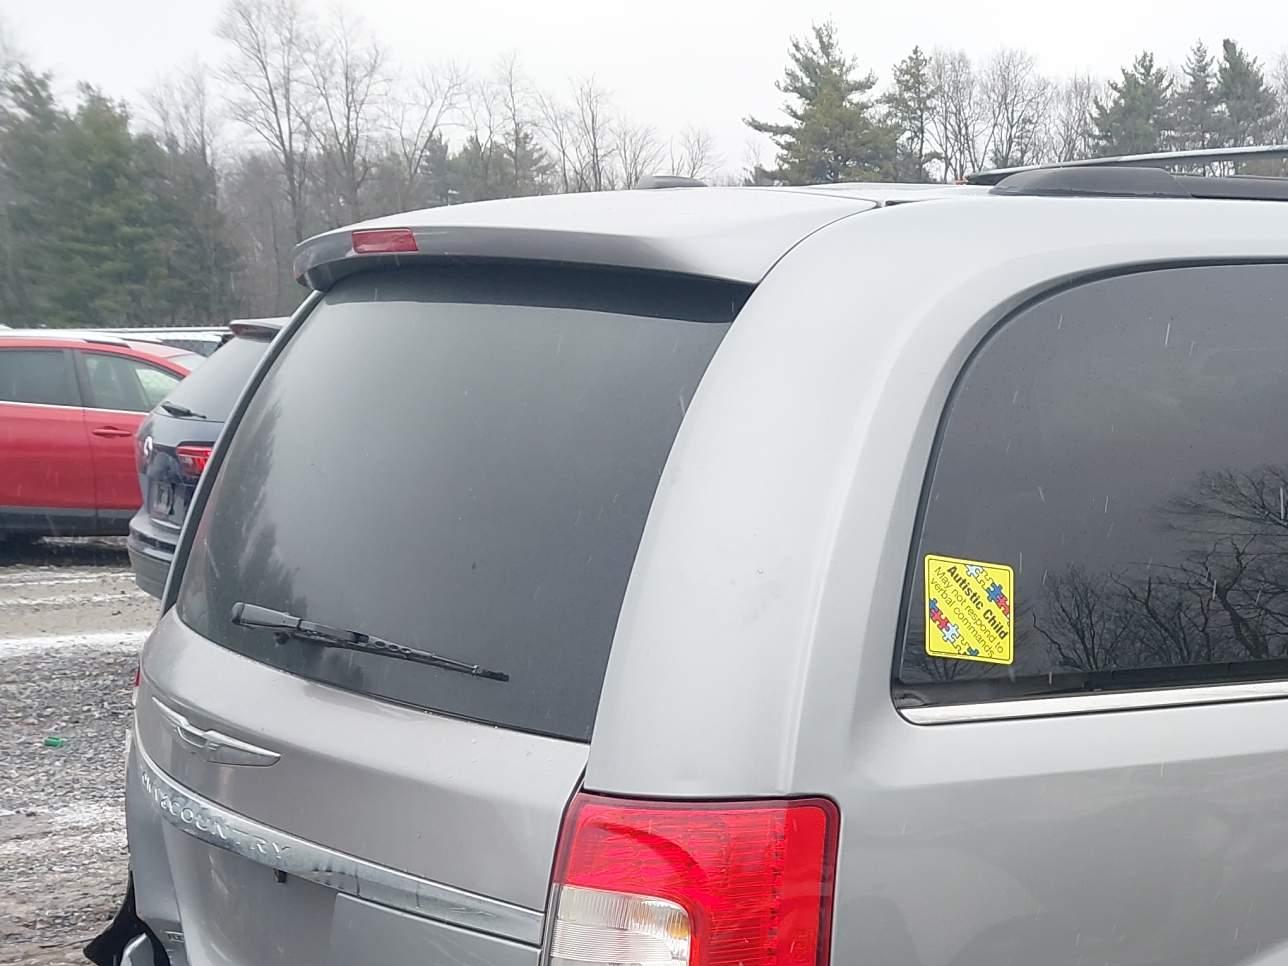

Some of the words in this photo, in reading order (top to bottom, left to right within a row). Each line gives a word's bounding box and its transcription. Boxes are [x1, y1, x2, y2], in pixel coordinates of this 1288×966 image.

[930, 577, 955, 608] verbal
[953, 607, 995, 659] commands
[933, 566, 954, 589] May
[952, 588, 968, 606] not
[965, 604, 998, 643] respond
[994, 641, 1004, 654] to
[947, 565, 984, 610] Autistic
[982, 608, 1009, 640] Child
